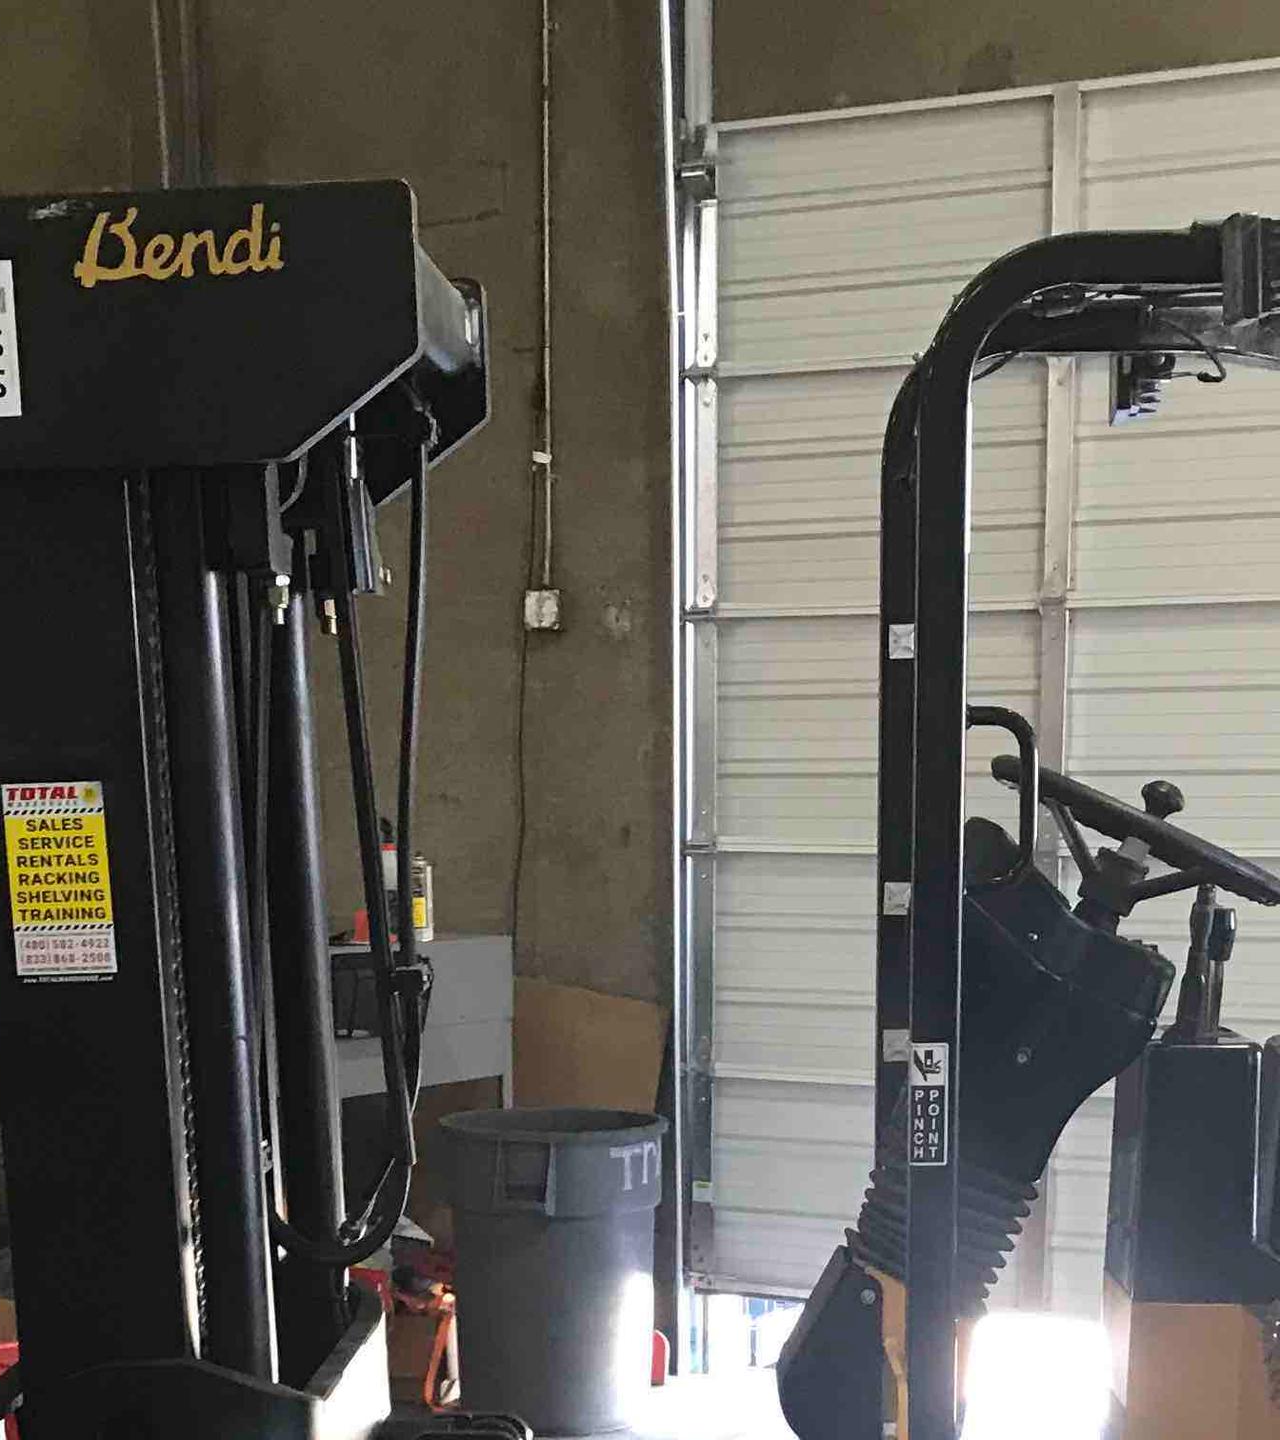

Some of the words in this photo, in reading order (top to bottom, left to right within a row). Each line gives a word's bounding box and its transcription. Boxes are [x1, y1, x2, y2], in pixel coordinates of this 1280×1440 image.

[73, 202, 285, 288] Bendi
[5, 786, 79, 801] TOTAL
[25, 817, 84, 833] SALES
[17, 835, 95, 850] SERVICE
[16, 853, 99, 868] RENTALS
[17, 871, 101, 886] RACKING
[16, 889, 106, 904] SHELVING
[17, 907, 107, 922] TRAINING
[913, 1090, 925, 1159] PINCH
[928, 1089, 940, 1159] POINT
